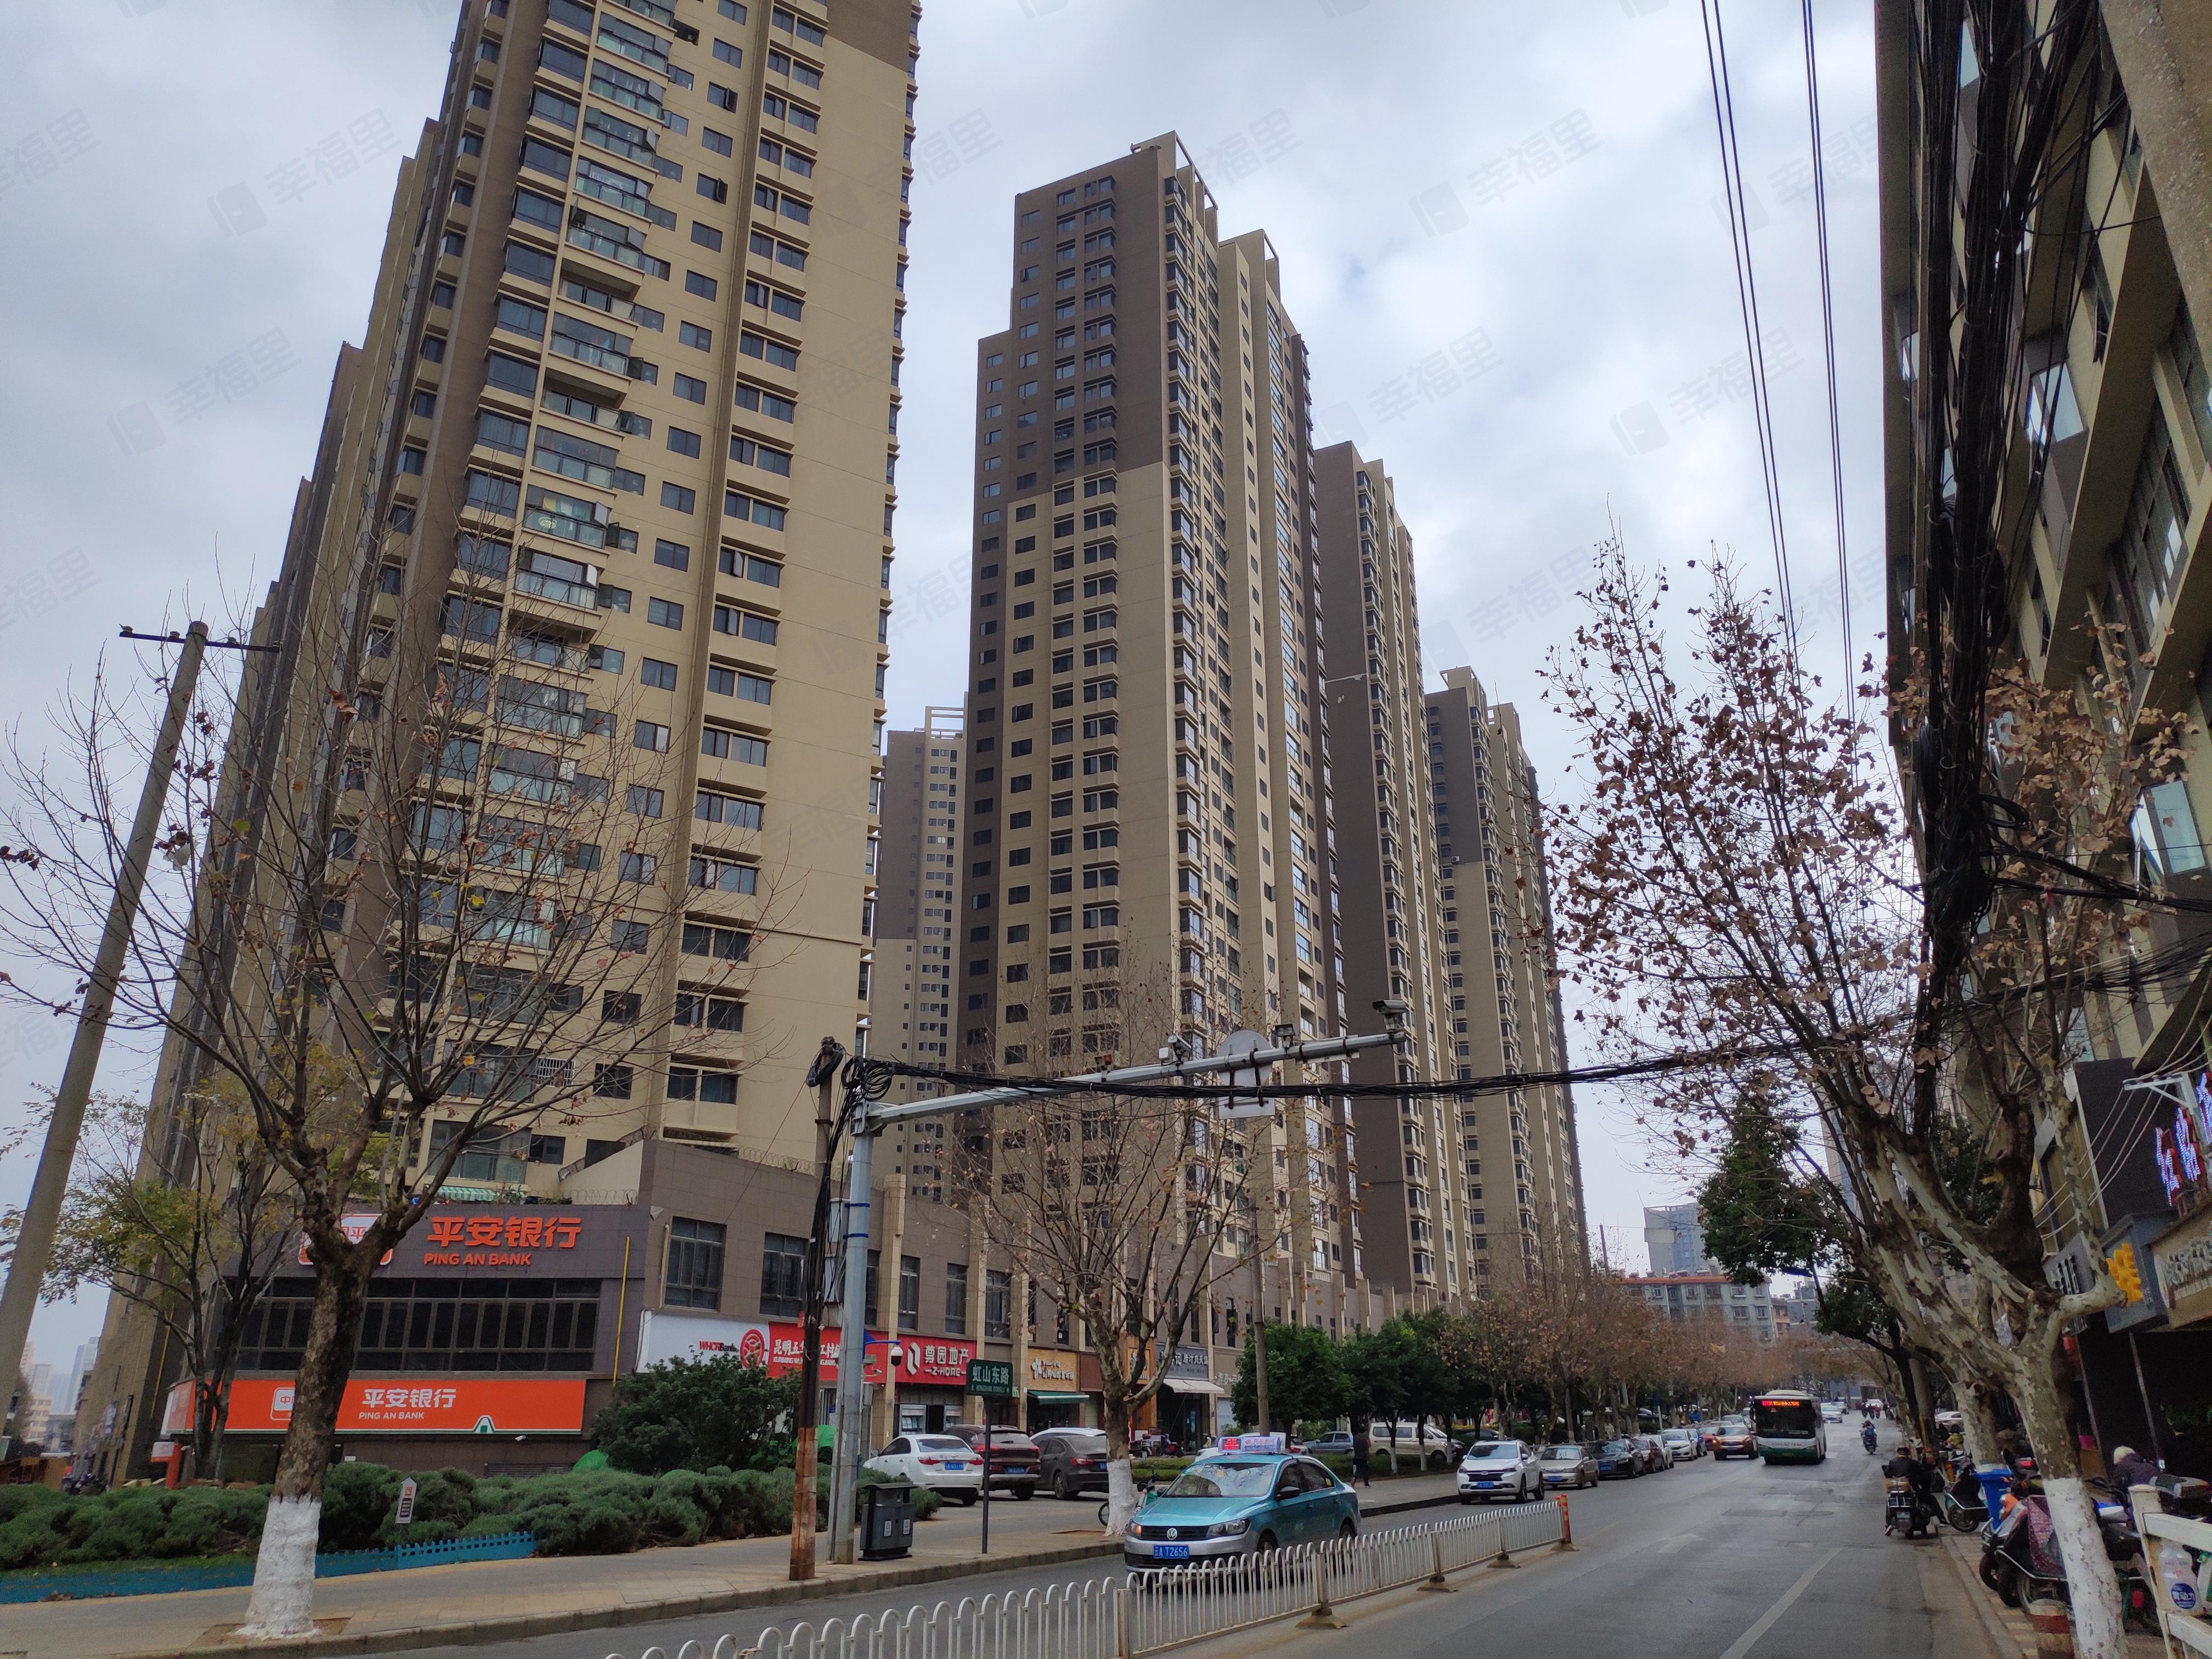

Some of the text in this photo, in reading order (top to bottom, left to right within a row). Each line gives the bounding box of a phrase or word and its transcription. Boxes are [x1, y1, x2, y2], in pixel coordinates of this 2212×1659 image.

[427, 1216, 582, 1248] 平安银行
[424, 1252, 531, 1266] PING AN BANK
[973, 1364, 1009, 1385] 虹山东路
[362, 1388, 456, 1408] 平安银行
[359, 1412, 381, 1420] PING
